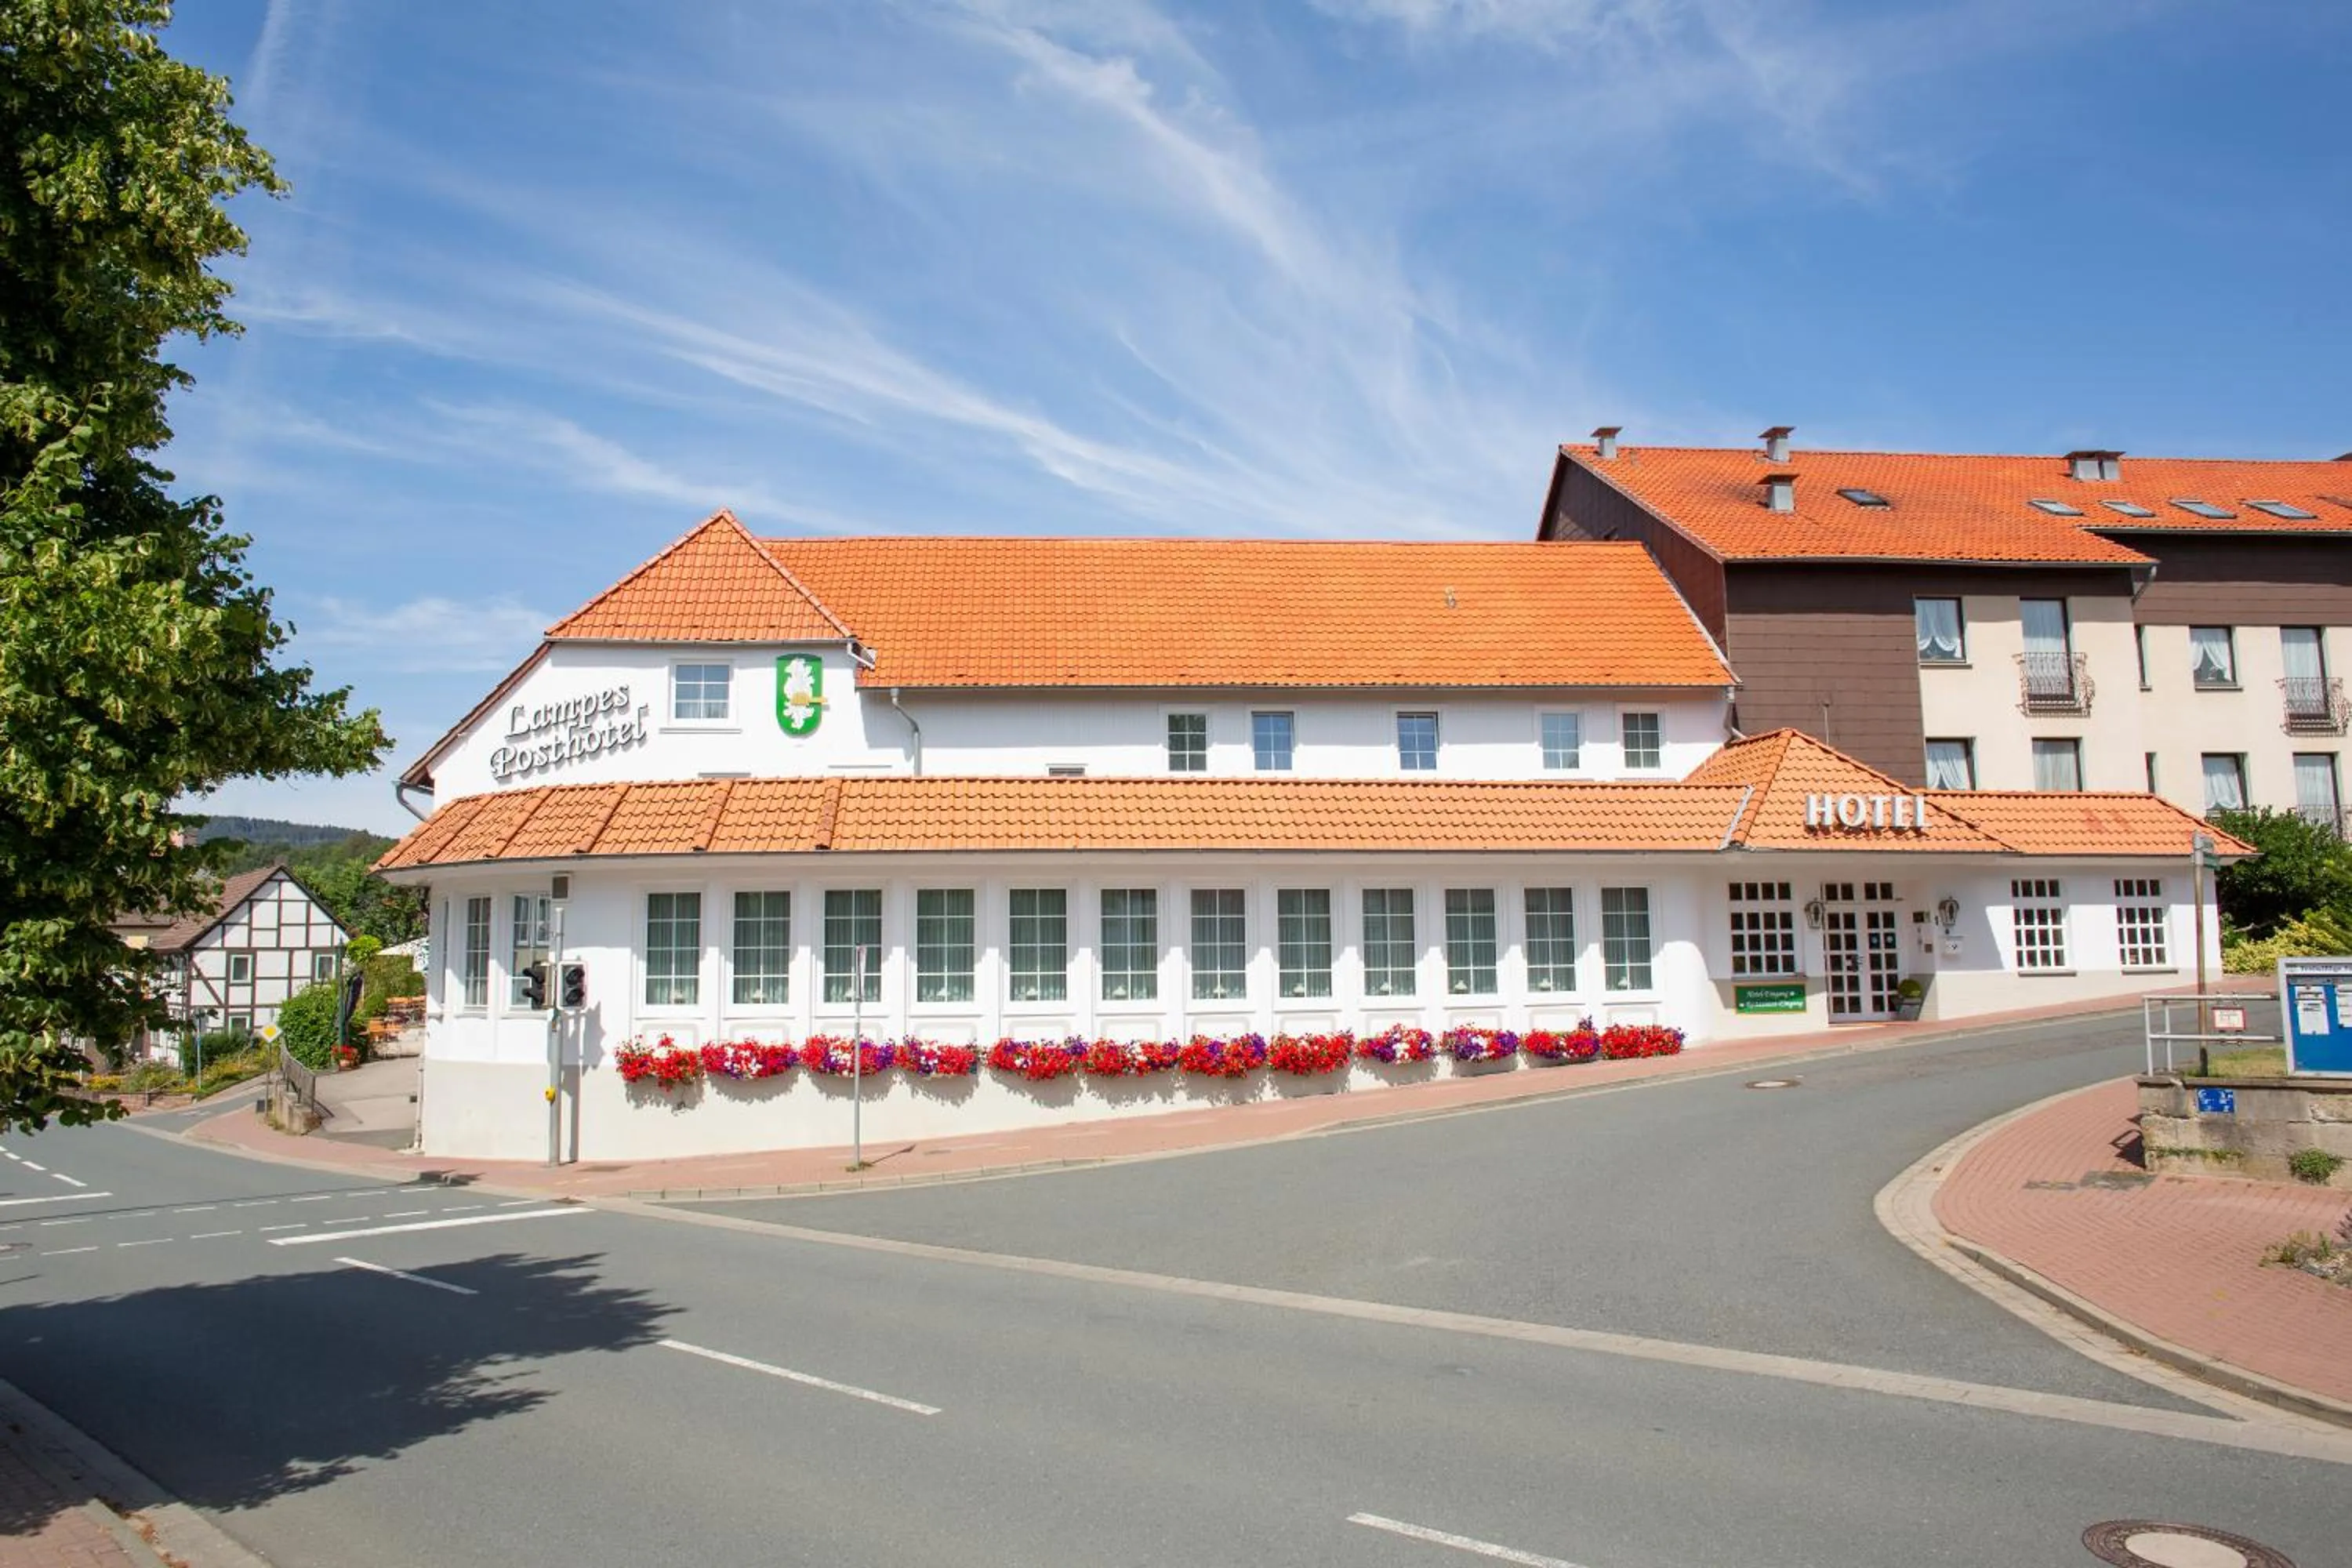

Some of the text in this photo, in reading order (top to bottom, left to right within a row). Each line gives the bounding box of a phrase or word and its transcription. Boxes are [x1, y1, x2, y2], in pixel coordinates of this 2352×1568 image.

[504, 684, 630, 739] Lampes
[490, 703, 649, 779] Posthotel
[1806, 793, 1933, 827] HOTEL
